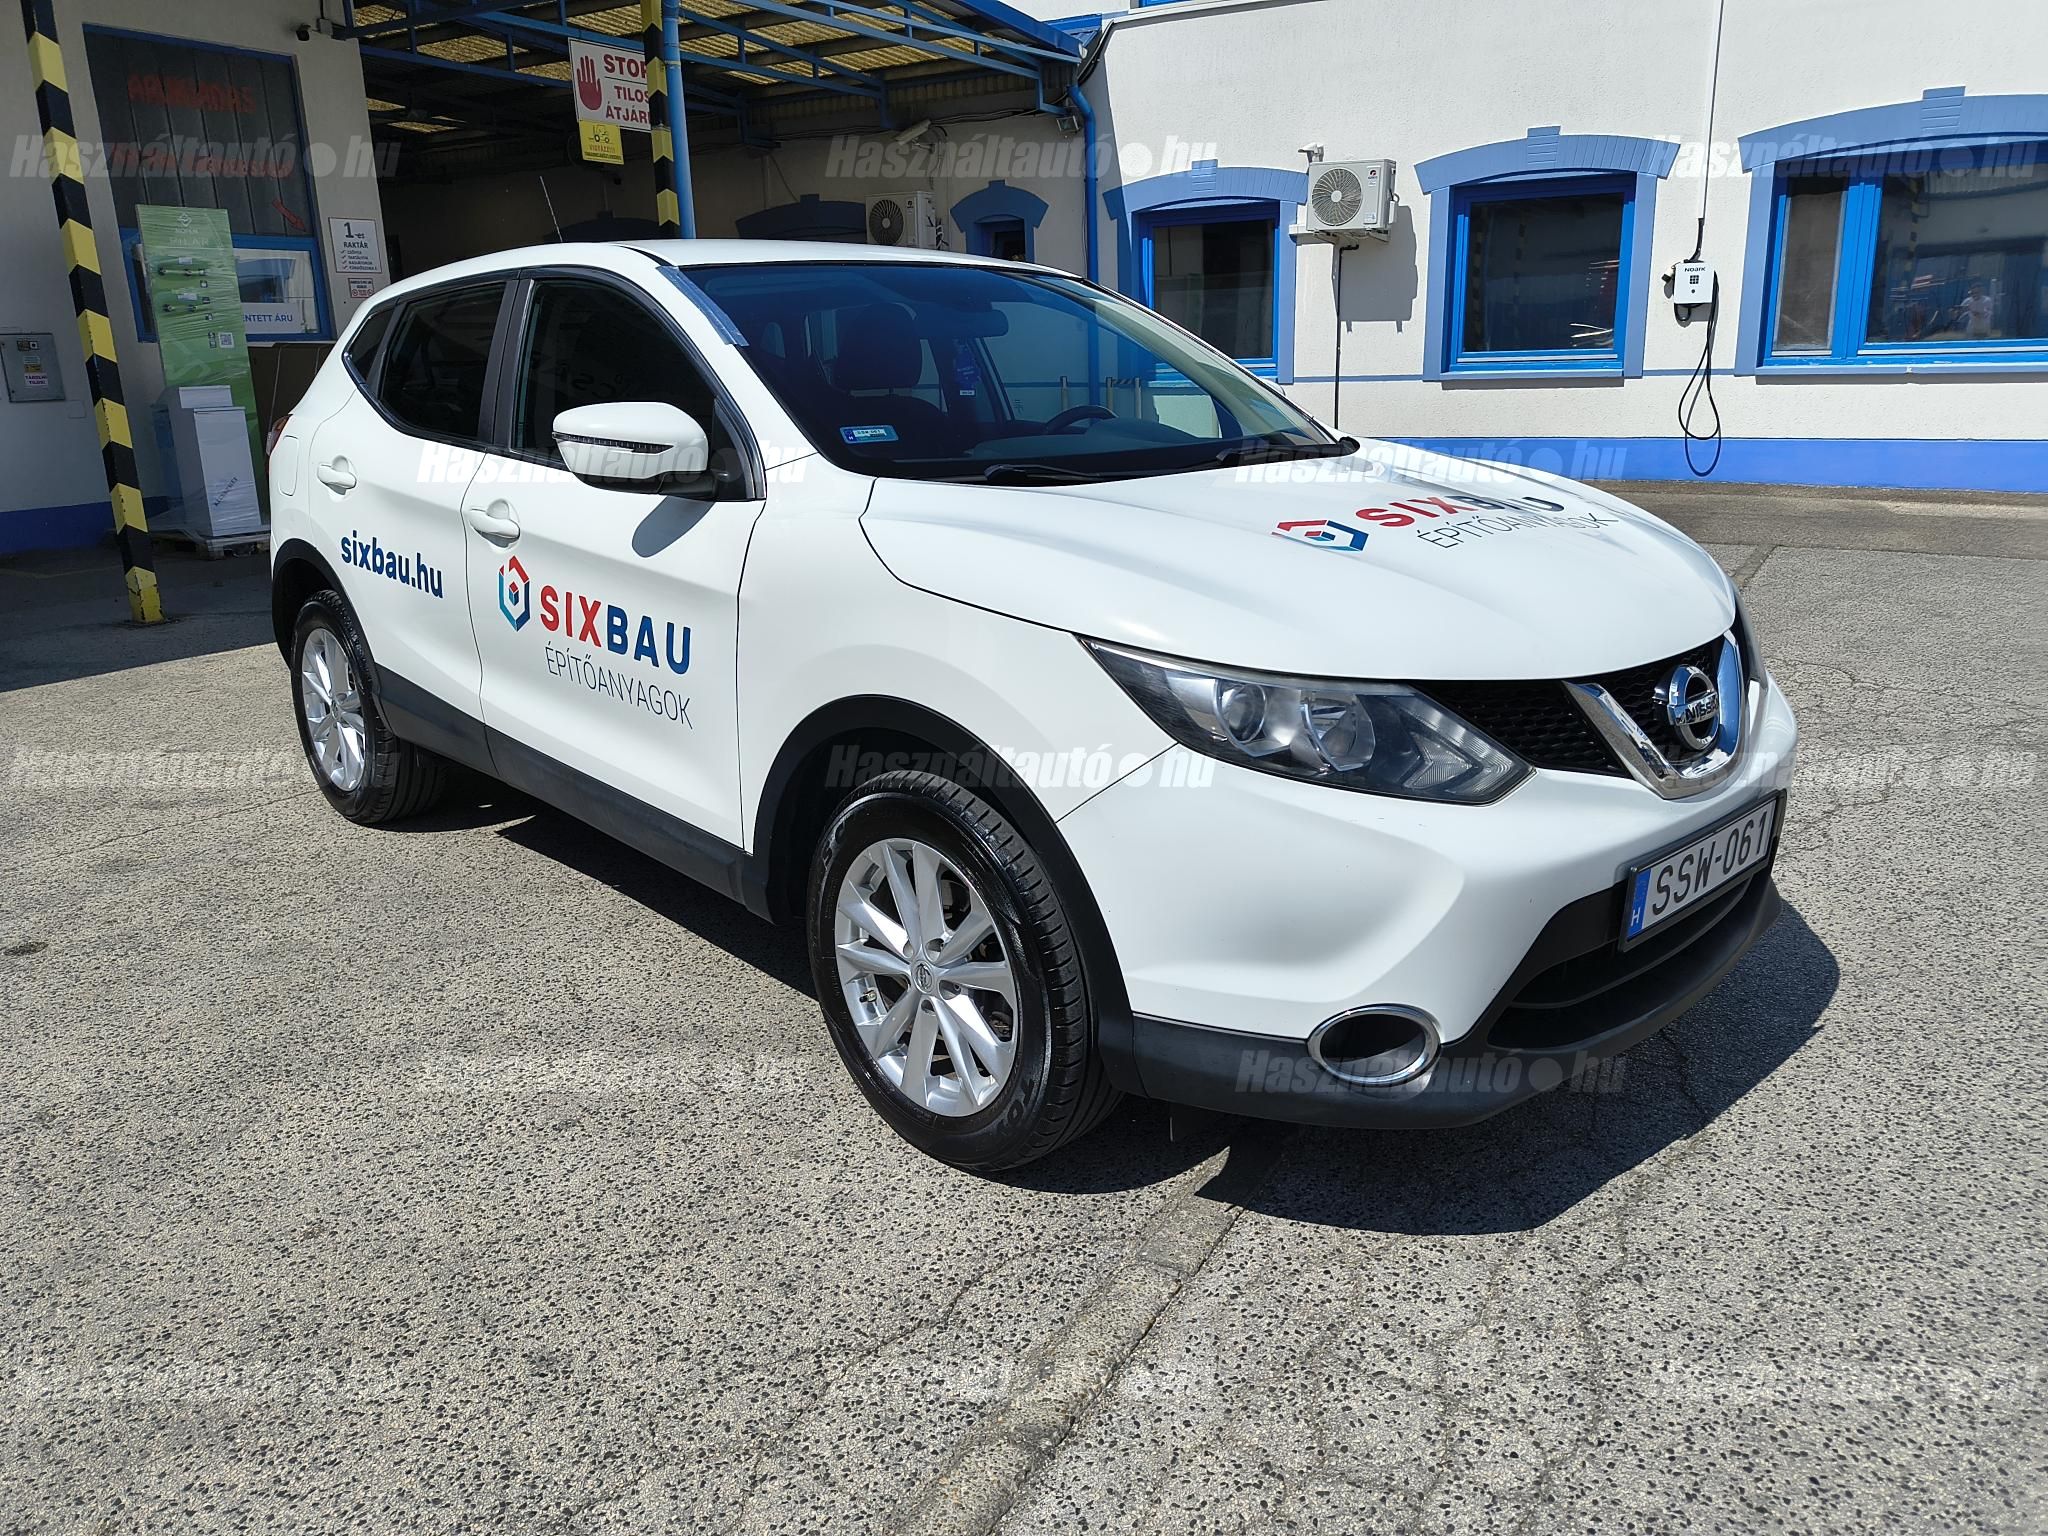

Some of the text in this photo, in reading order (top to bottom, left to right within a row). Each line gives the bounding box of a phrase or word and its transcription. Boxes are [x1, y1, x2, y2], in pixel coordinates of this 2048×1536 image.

[343, 240, 369, 249] RAKTÁR
[243, 312, 293, 322] NTETT ÁRU
[1355, 496, 1566, 528] SIXBAU
[340, 530, 444, 599] sixbau.hu
[540, 584, 692, 675] SIXBAU
[544, 640, 694, 730] ÉPÍTŐANYAGOK
[1652, 810, 1768, 917] SSW-061
[1630, 905, 1641, 929] H
